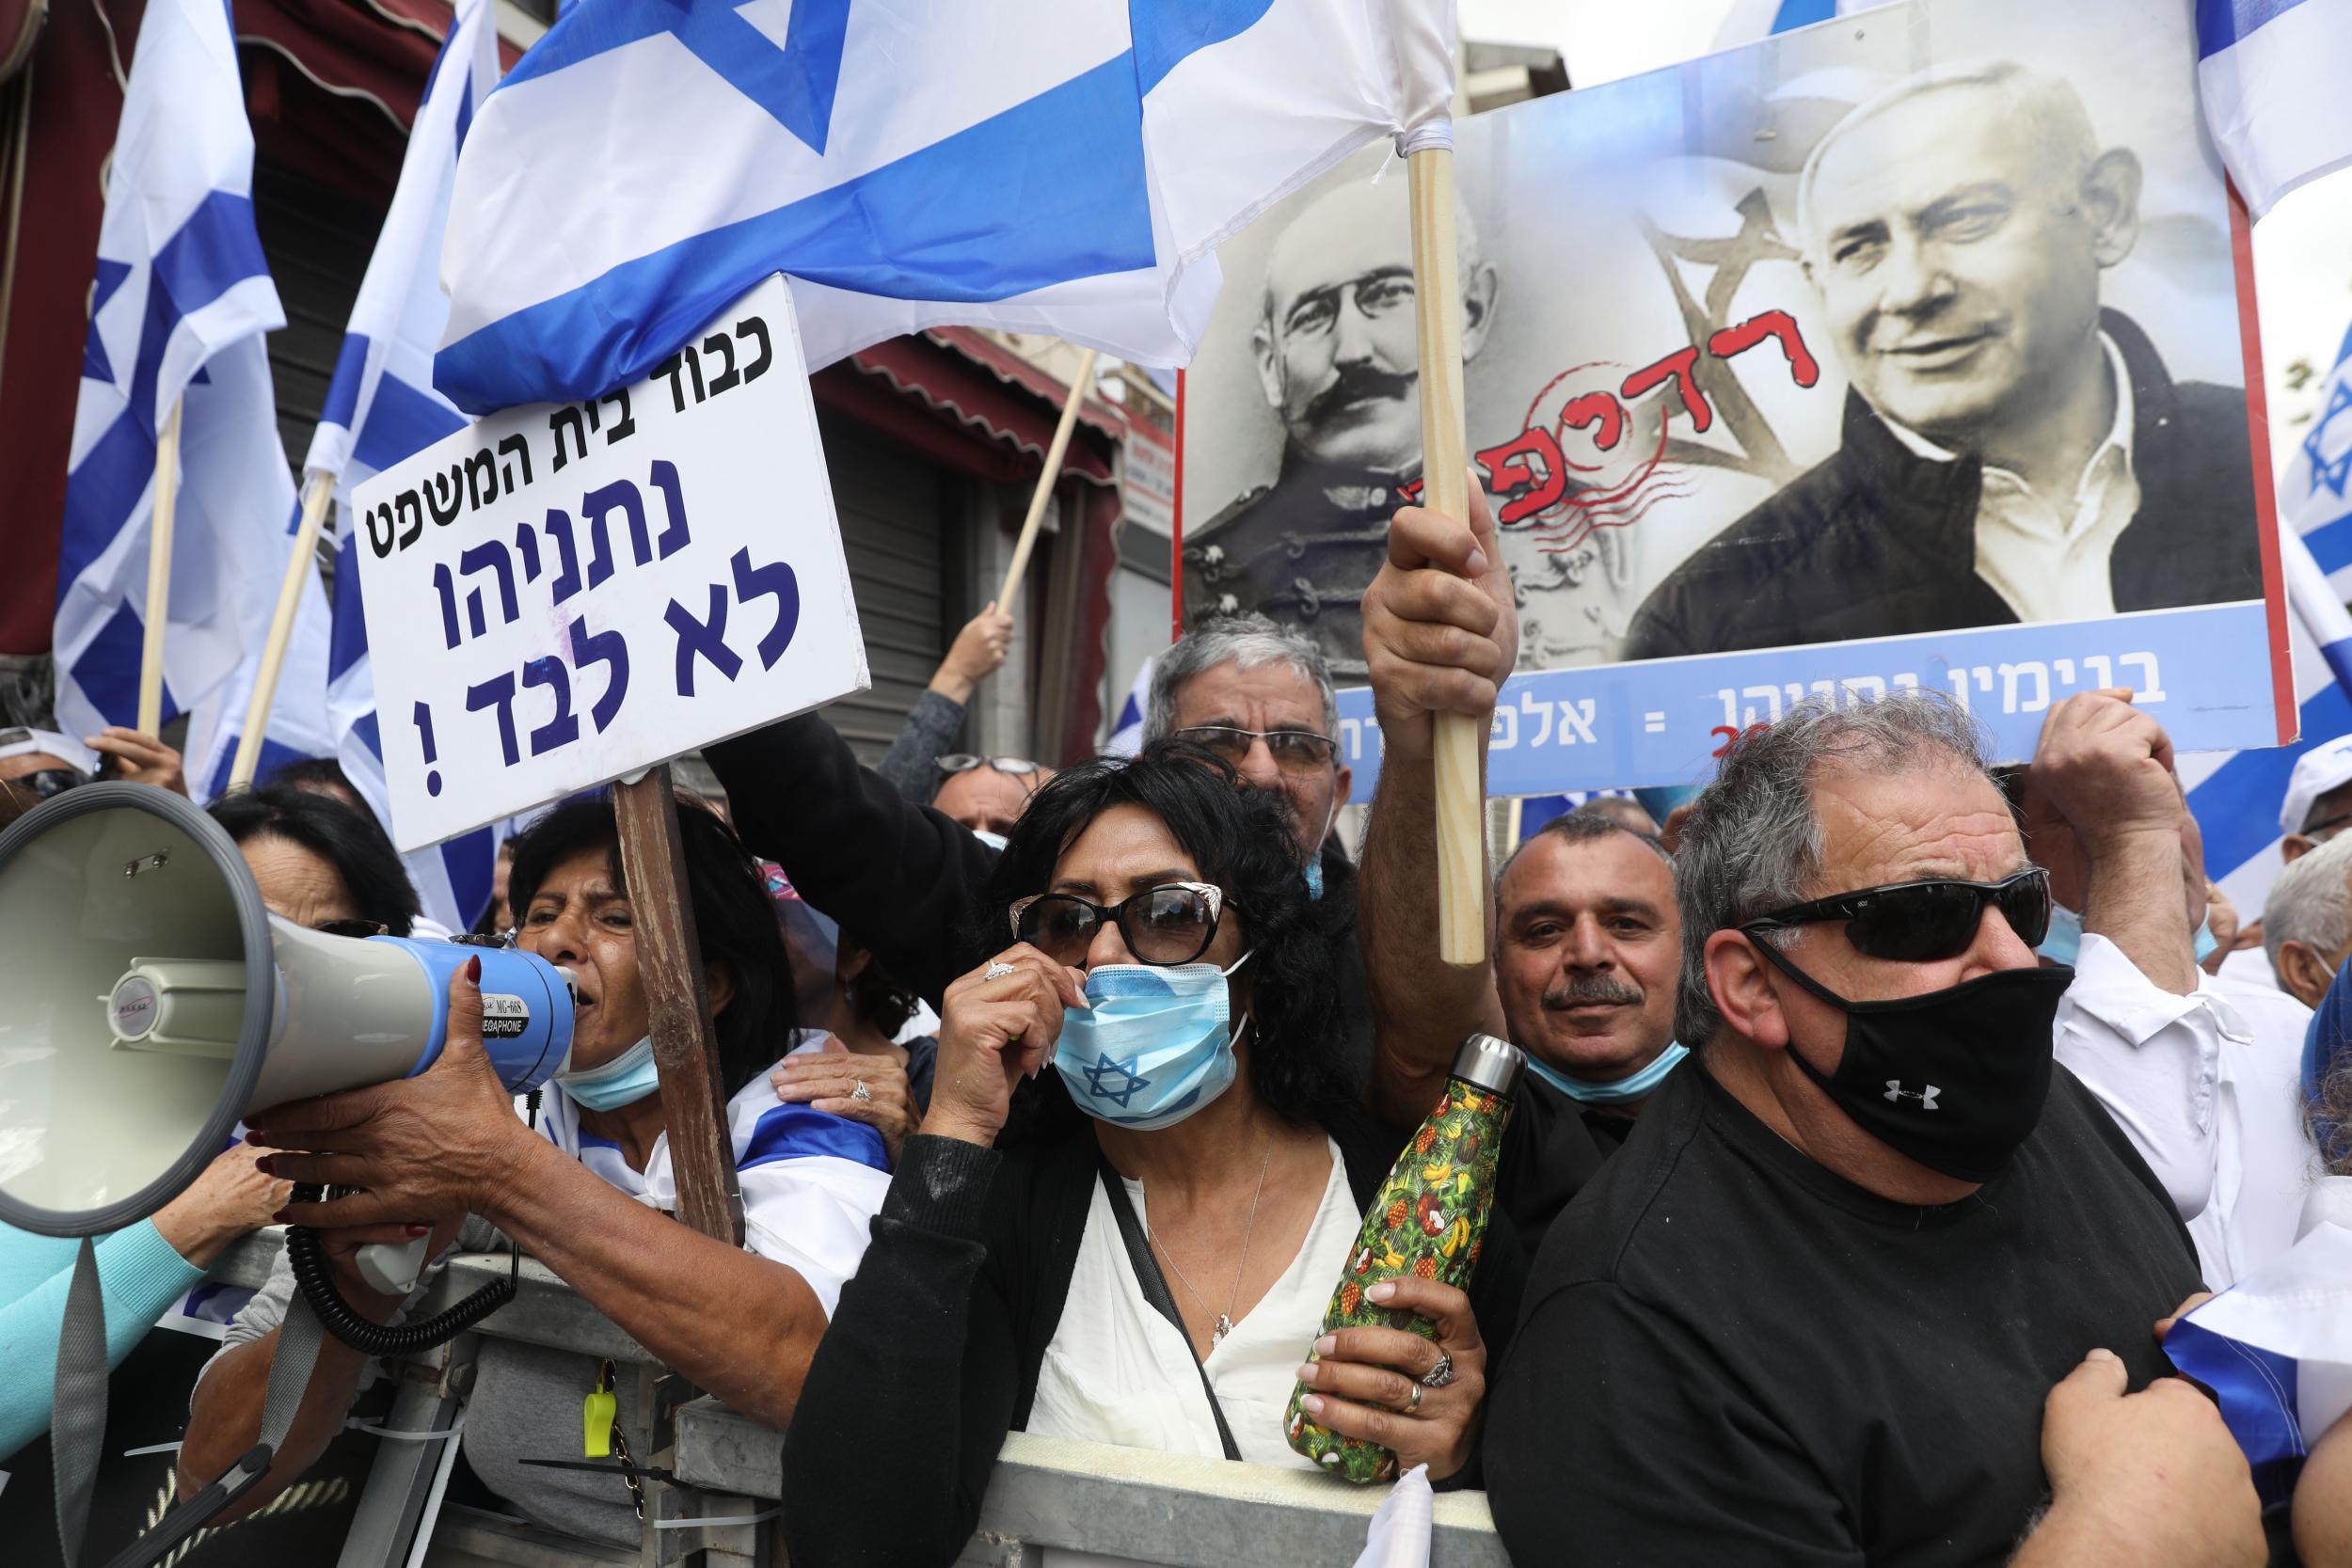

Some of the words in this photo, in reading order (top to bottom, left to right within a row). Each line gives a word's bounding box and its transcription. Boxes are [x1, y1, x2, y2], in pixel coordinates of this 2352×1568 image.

[649, 315, 773, 415] כבוד
[1396, 309, 1820, 526] רדיפ
[548, 388, 637, 475] בית
[365, 433, 533, 560] המשפט
[433, 459, 691, 651] נתניהו
[663, 546, 802, 698] לא
[465, 614, 630, 768] לבד
[1488, 691, 1597, 750] אלפ
[1947, 651, 2166, 717] בנימין
[482, 1020, 522, 1033] EGAPHONE
